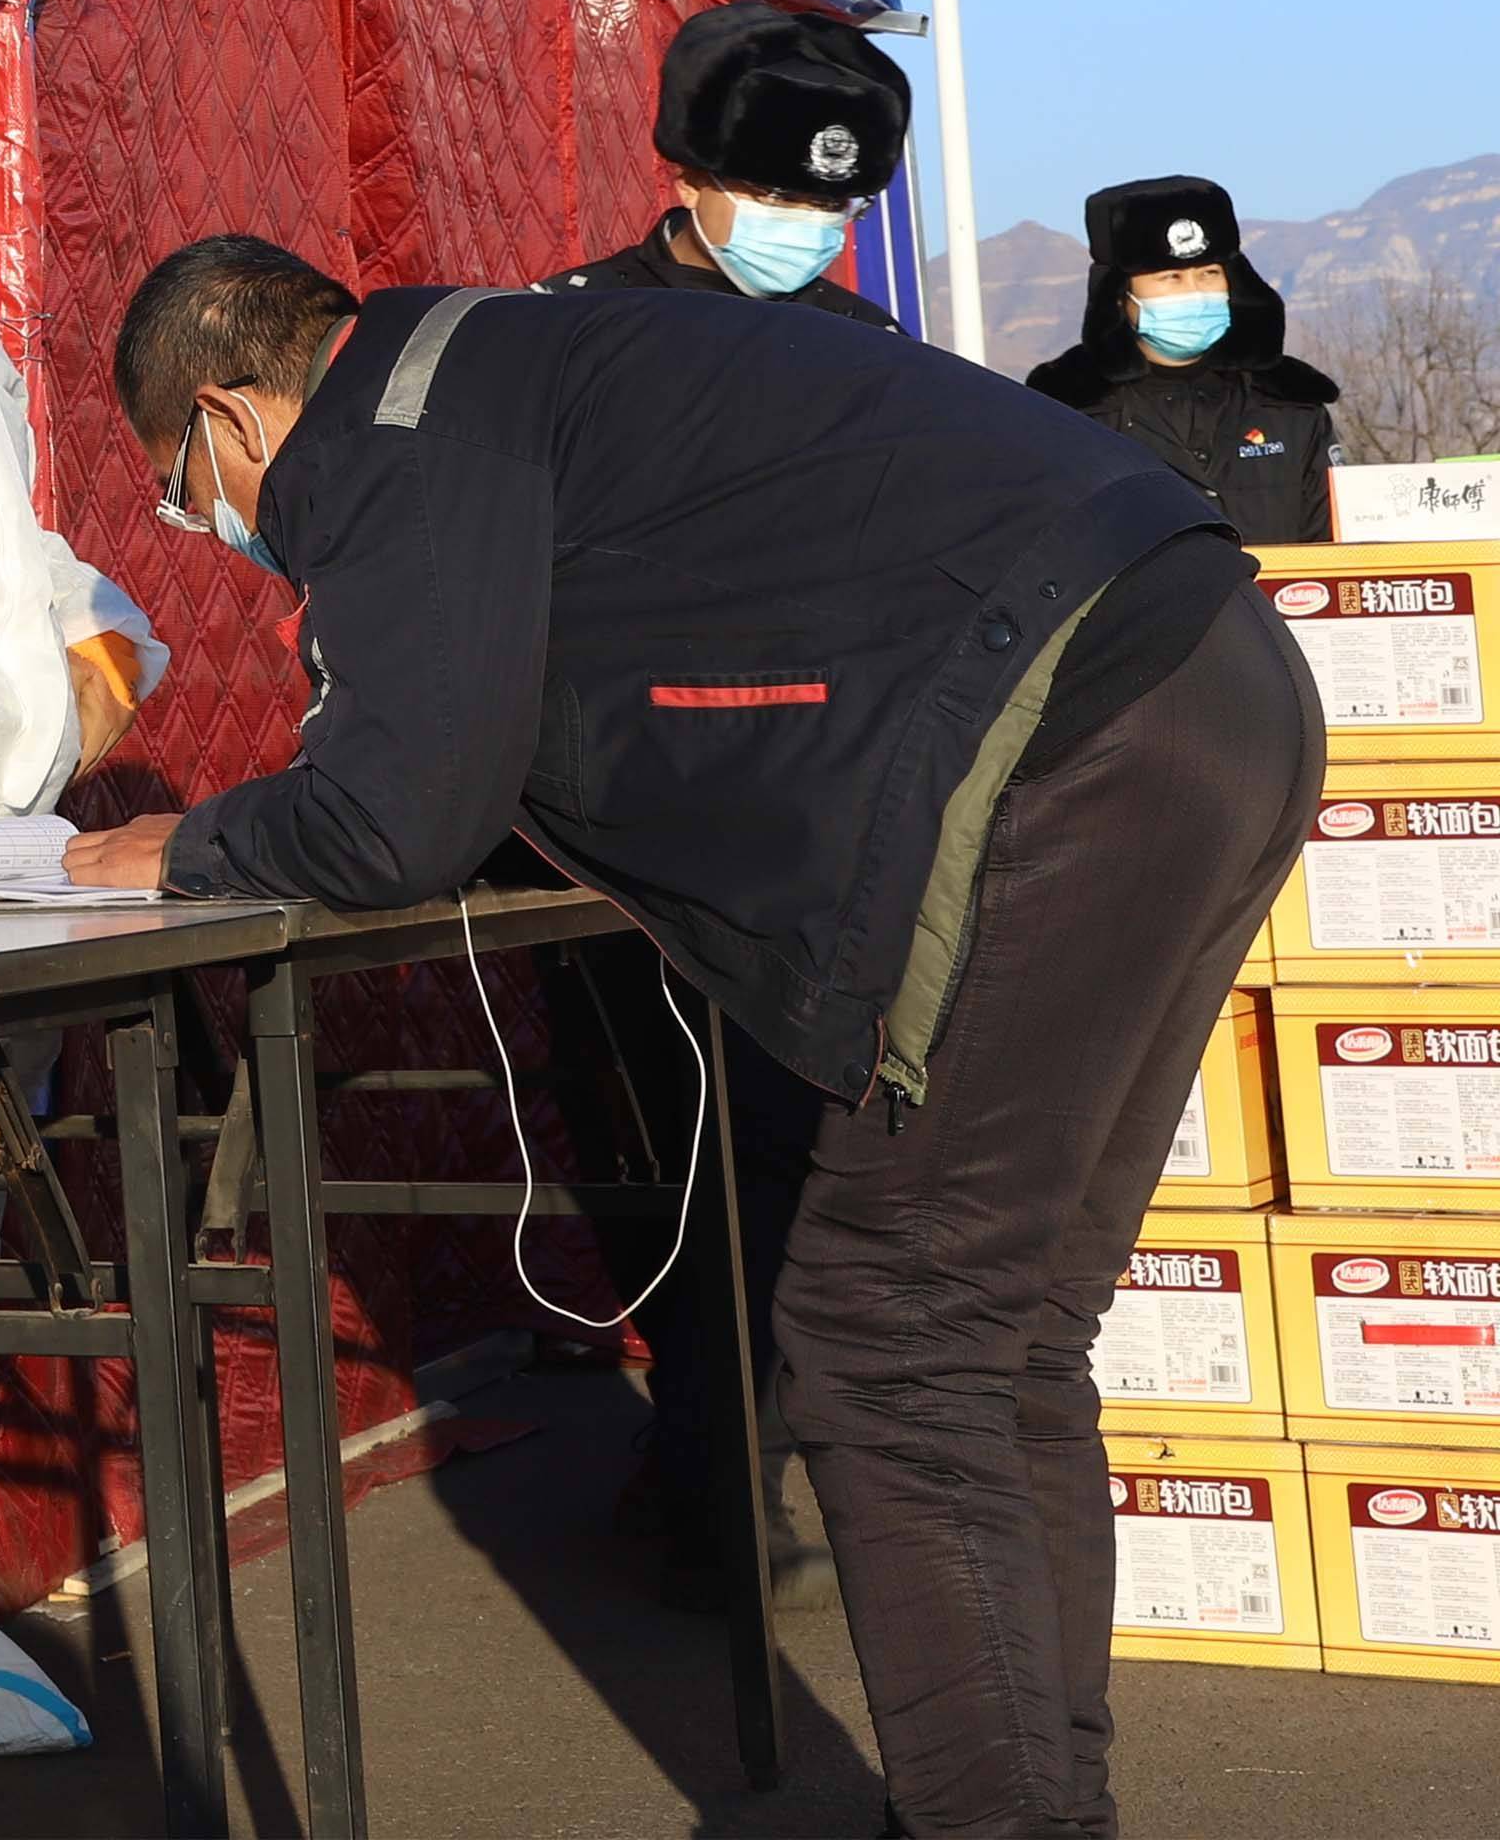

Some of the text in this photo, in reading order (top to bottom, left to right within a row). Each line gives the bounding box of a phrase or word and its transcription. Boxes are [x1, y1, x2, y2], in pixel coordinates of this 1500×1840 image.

[1418, 477, 1487, 514] 康師傅
[1361, 579, 1455, 613] 软面包
[1407, 801, 1500, 835] 软面包
[1129, 1253, 1223, 1288] 软面包
[1158, 1479, 1254, 1516] 软面包
[1460, 1494, 1500, 1530] 软
